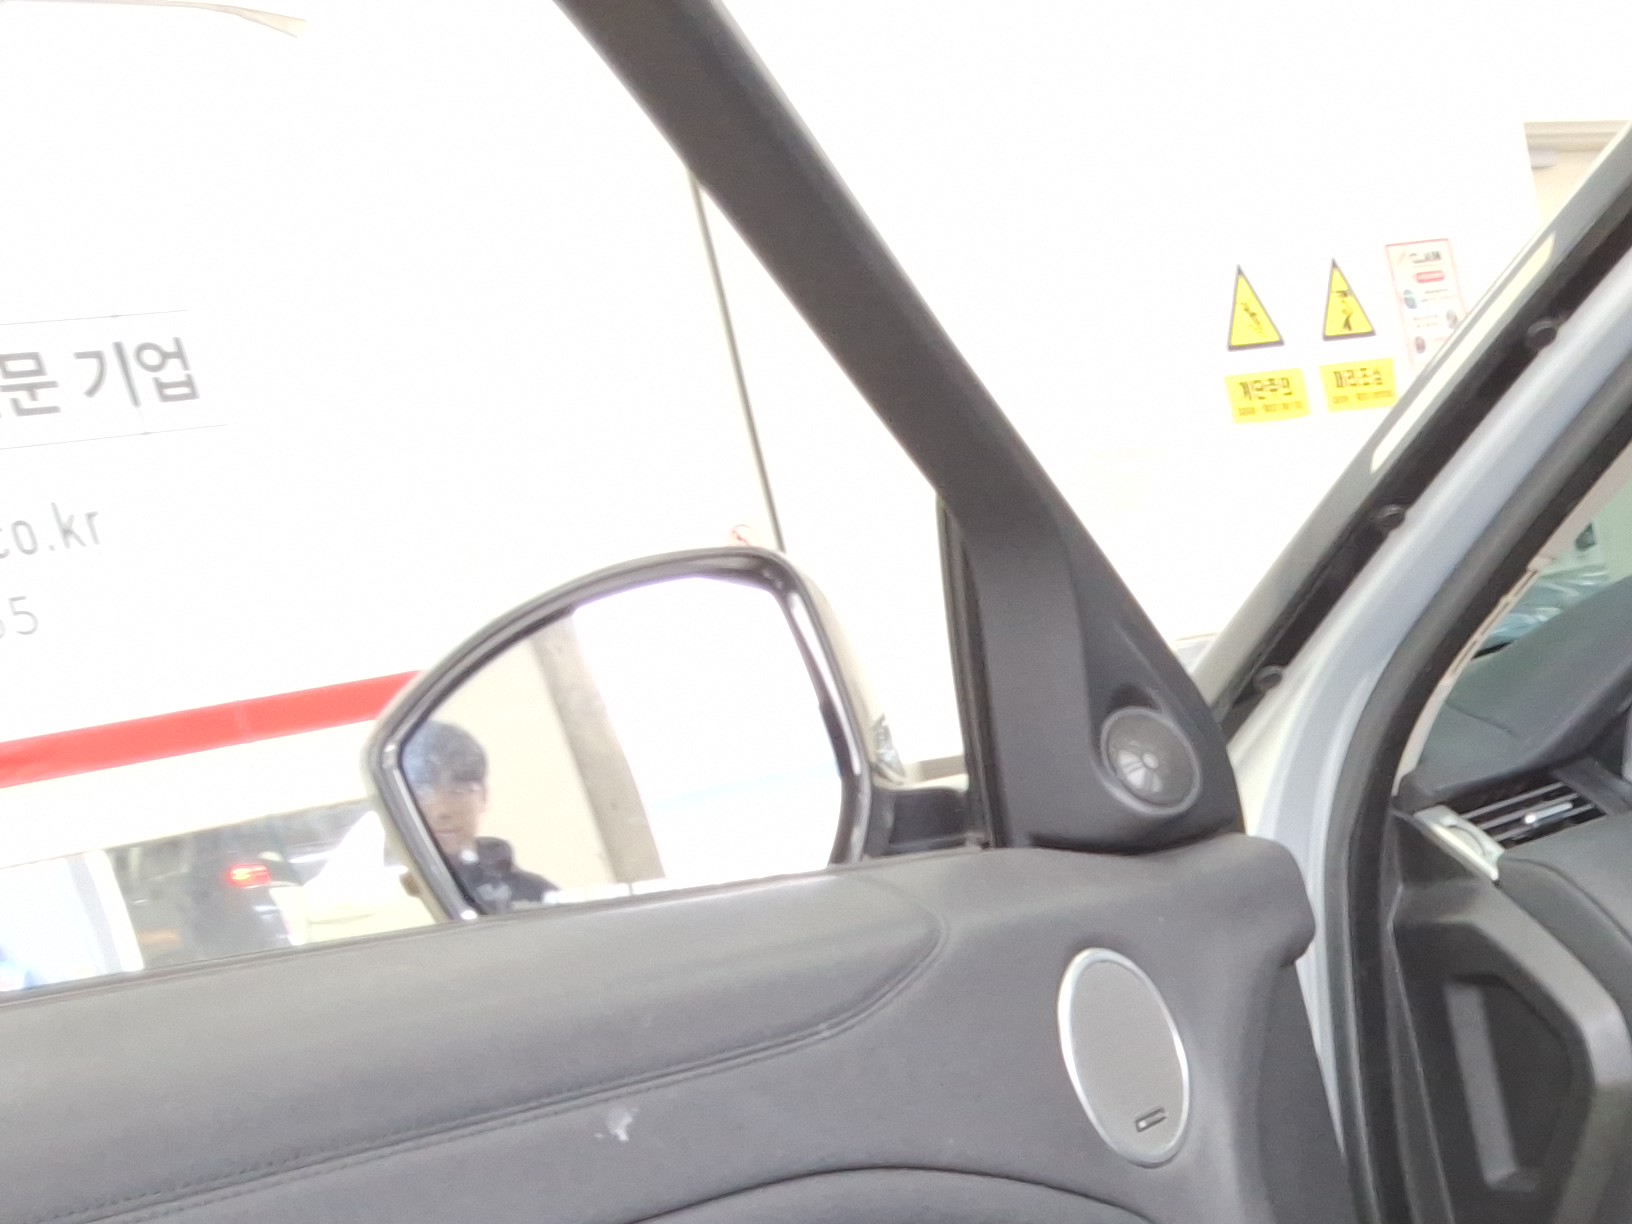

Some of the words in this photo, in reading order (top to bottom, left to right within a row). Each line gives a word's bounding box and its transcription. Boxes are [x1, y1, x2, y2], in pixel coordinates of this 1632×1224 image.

[0, 351, 61, 417] 문
[73, 336, 201, 408] 기업
[0, 595, 39, 639] 5
